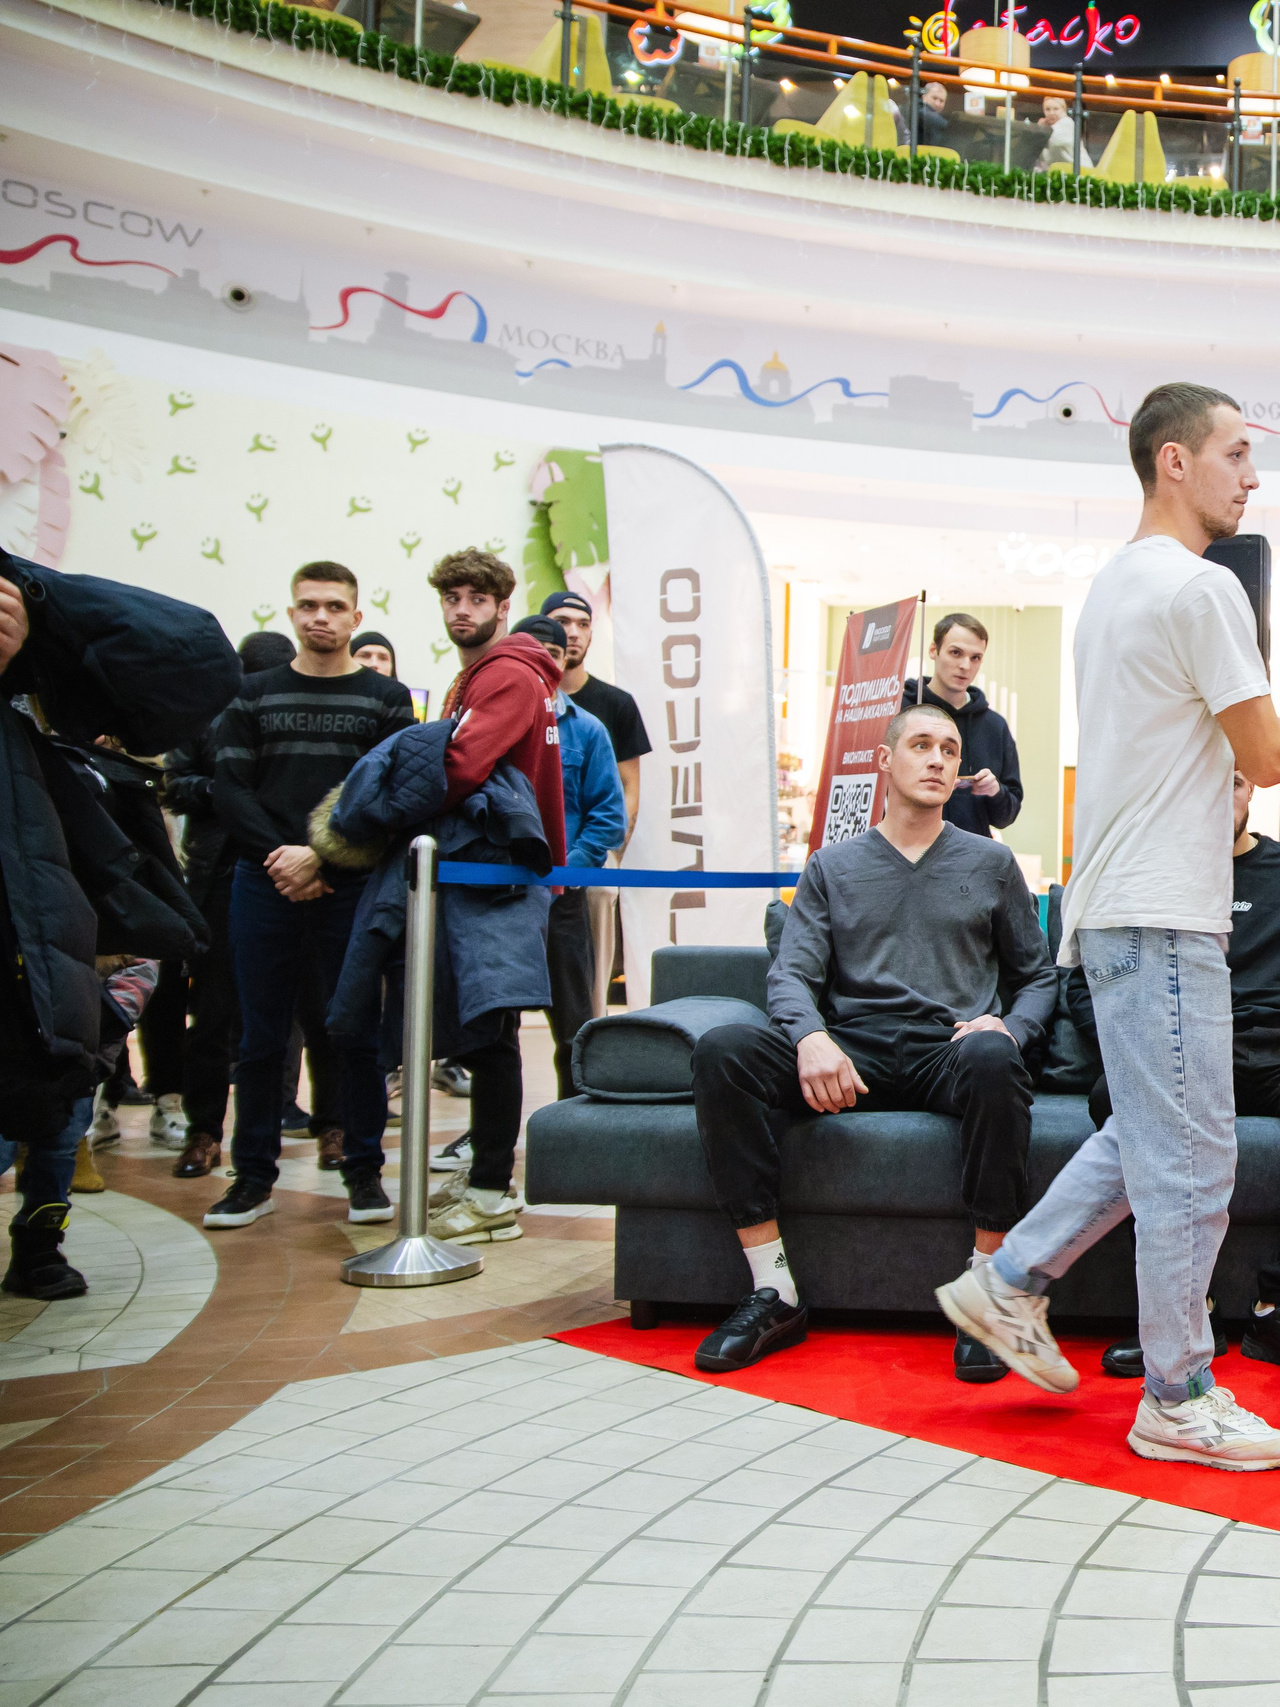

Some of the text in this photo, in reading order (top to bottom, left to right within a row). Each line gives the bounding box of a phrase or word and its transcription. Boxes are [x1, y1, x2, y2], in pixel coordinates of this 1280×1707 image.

[499, 323, 626, 363] МОСКВА
[841, 675, 900, 707] ПОДПИШИСЬ
[259, 712, 378, 738] BIKKEMBERGS
[863, 701, 897, 720] АККАУНТЫ
